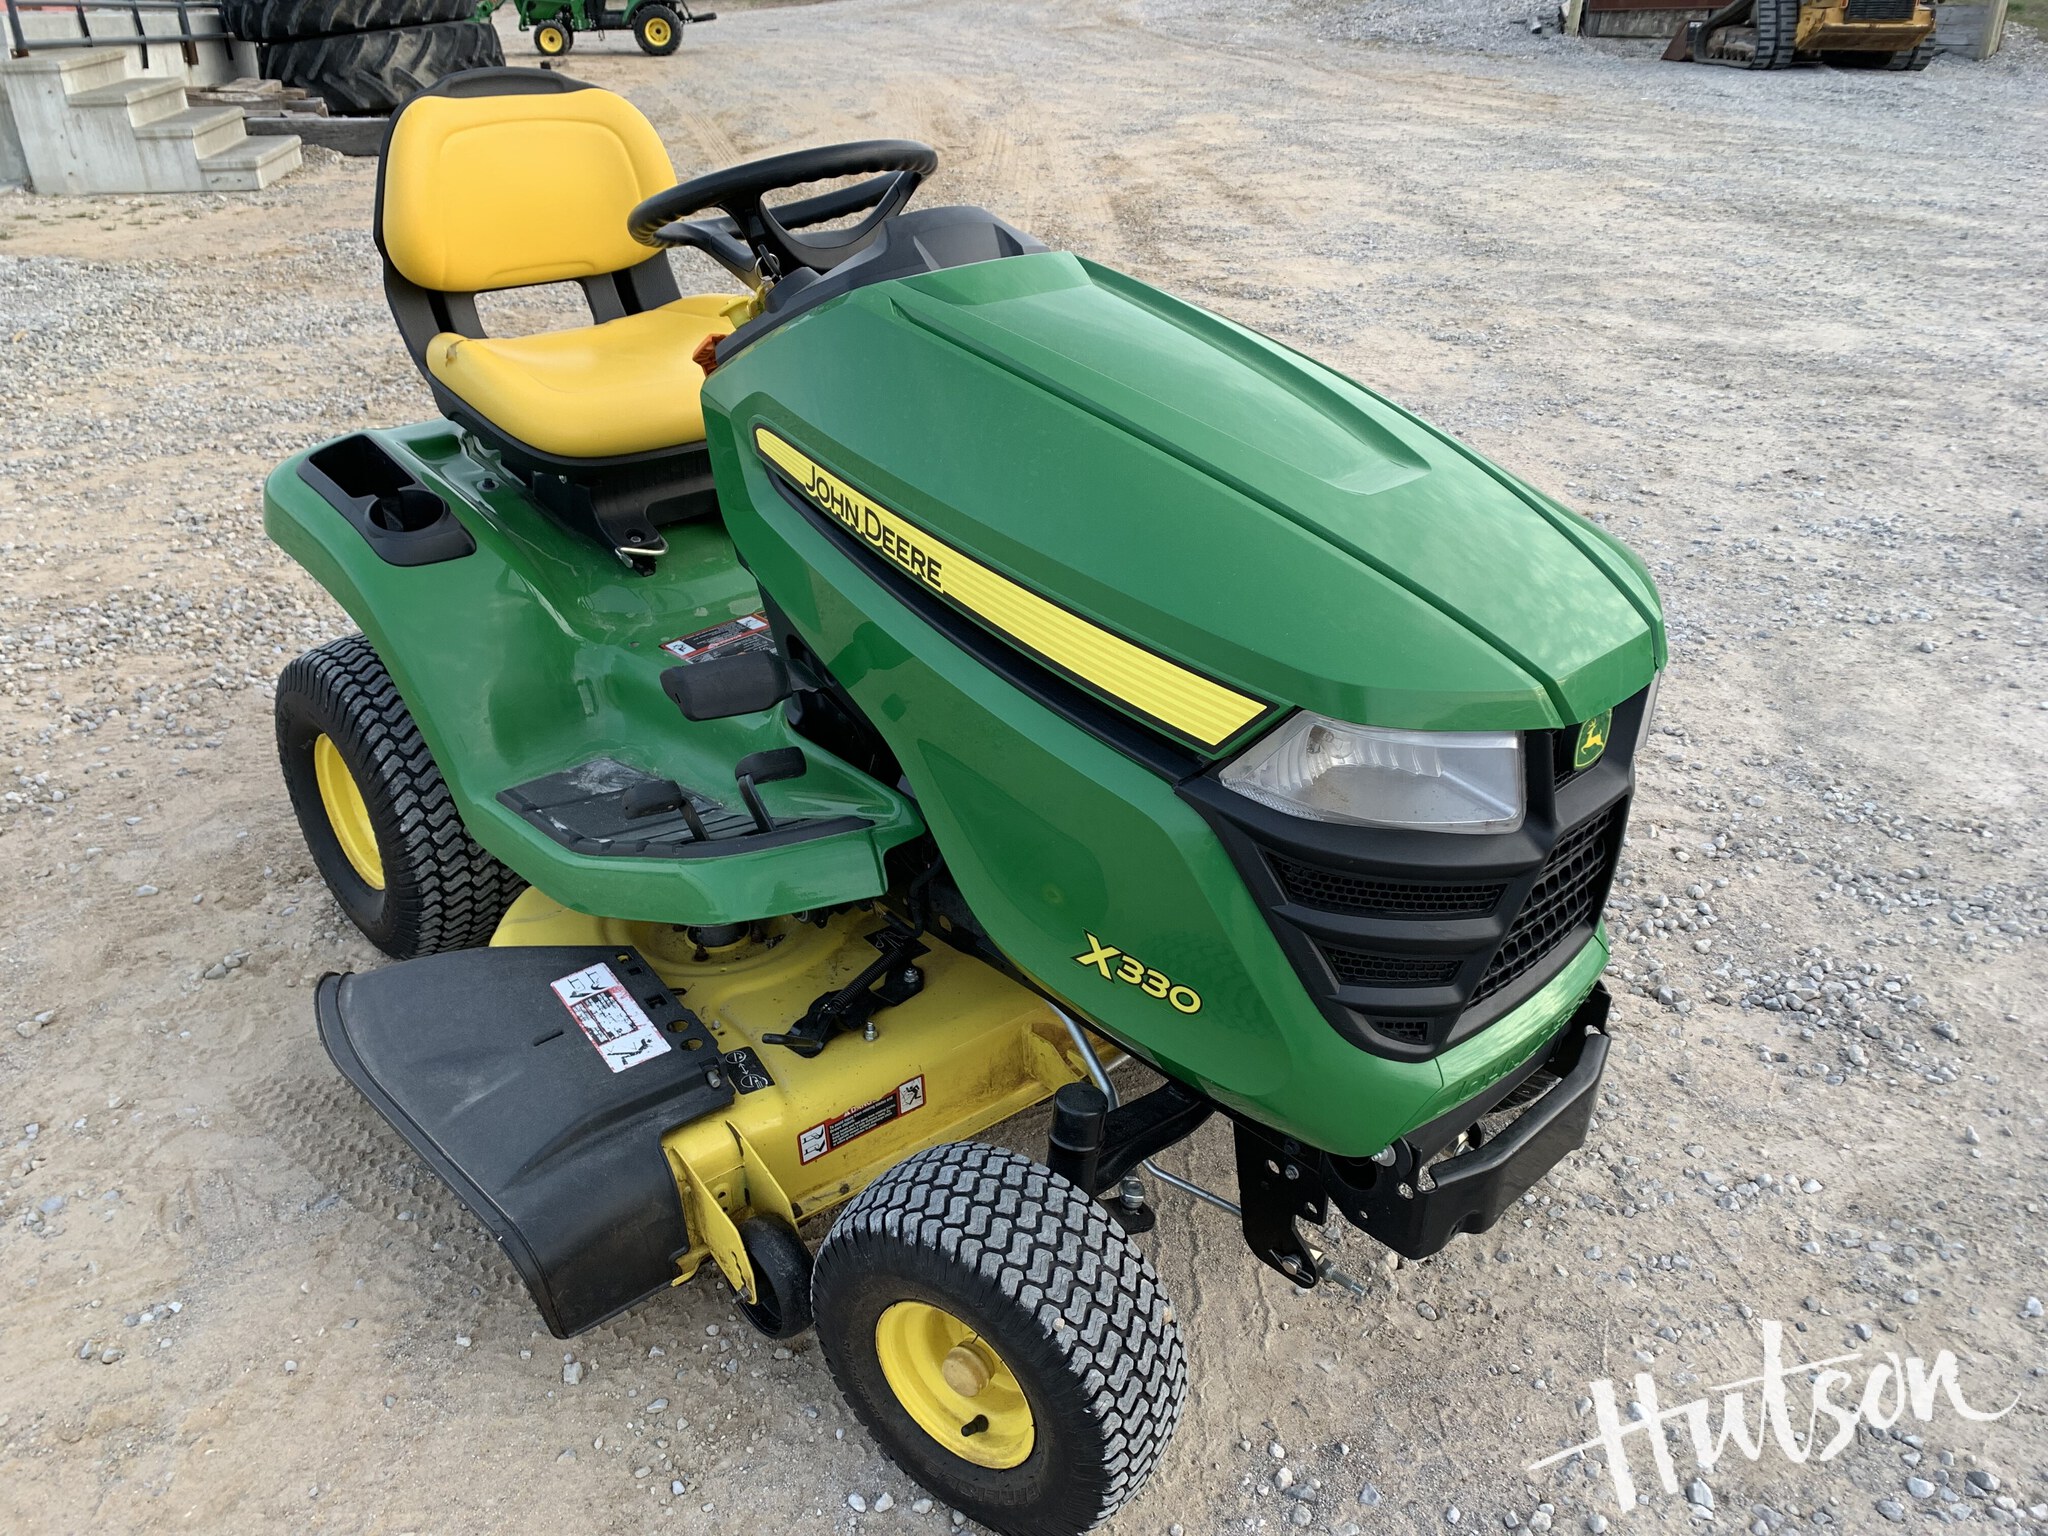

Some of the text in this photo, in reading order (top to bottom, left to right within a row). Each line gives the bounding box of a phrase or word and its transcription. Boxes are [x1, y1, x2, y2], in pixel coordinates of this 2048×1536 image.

[805, 465, 943, 590] JOHN DEERE
[1071, 928, 1203, 1015] X330
